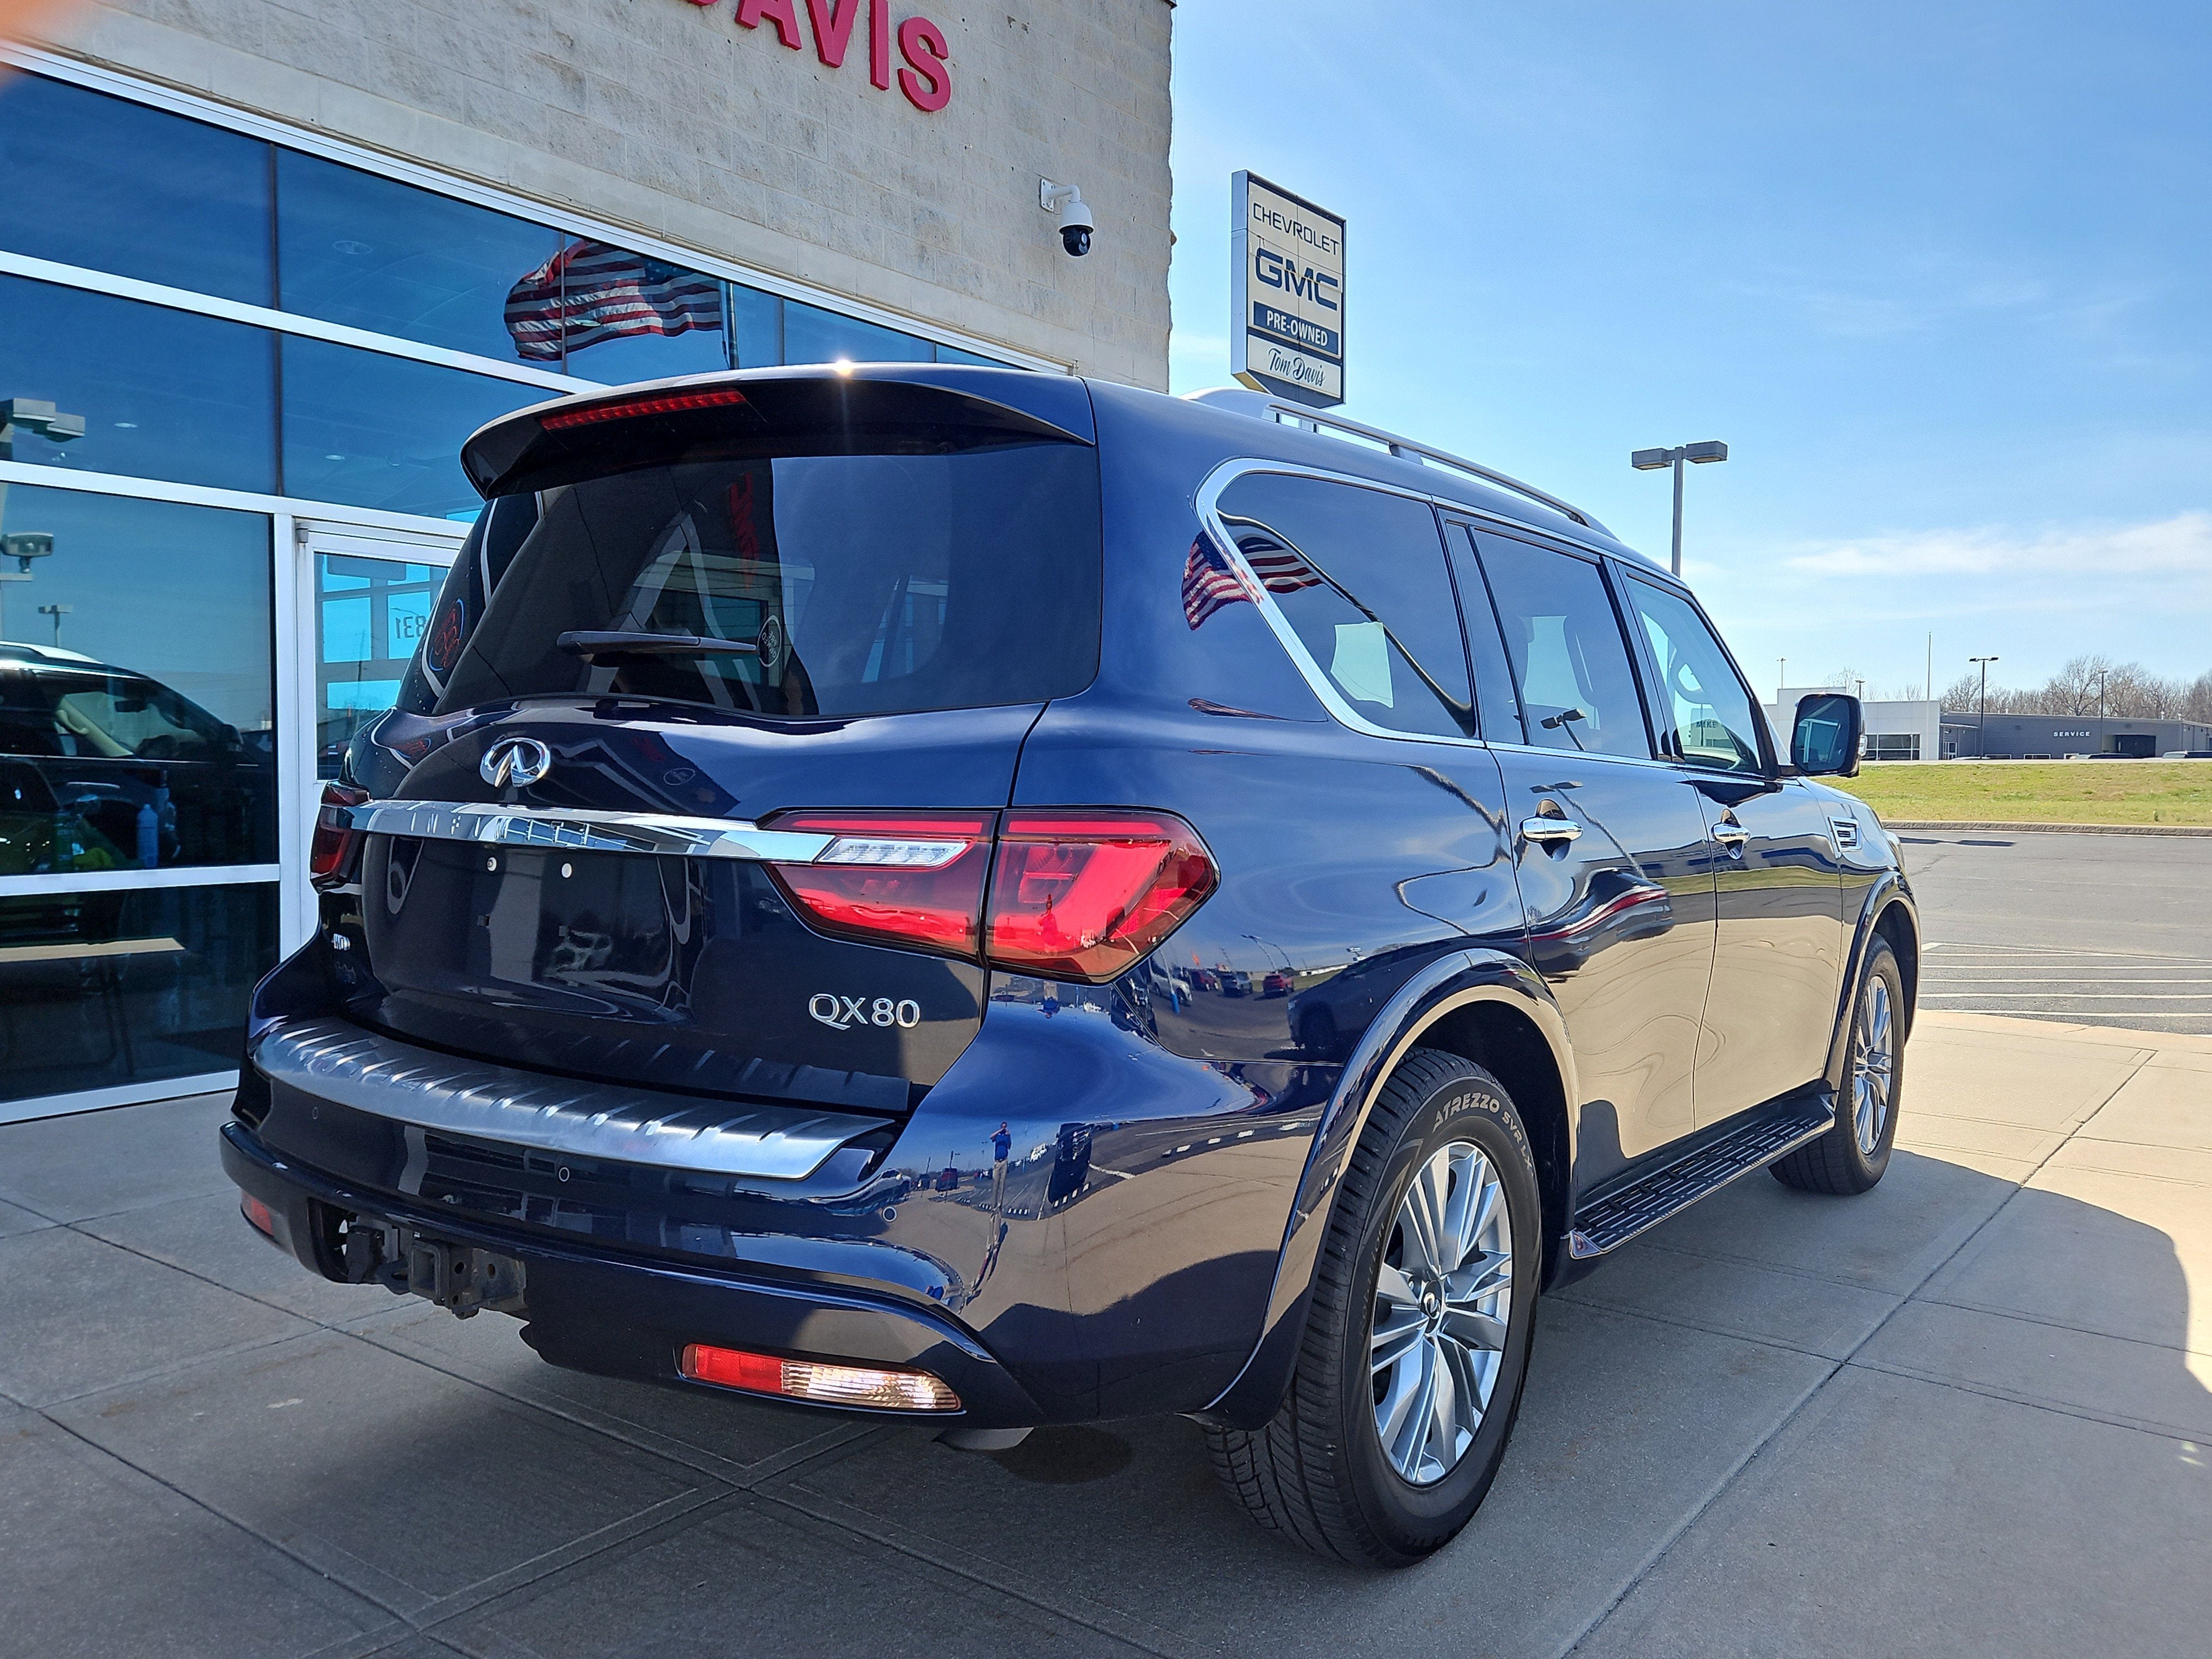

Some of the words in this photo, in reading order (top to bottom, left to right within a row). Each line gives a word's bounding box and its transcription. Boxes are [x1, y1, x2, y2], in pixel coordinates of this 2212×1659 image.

[687, 0, 951, 112] VIS
[1253, 203, 1339, 255] CHEVROLET
[1255, 247, 1339, 312] GMC
[1266, 310, 1328, 347] PRE-OWNED
[1268, 348, 1292, 375] Tom
[1290, 357, 1326, 387] Davis
[808, 993, 921, 1031] QX80
[1432, 1092, 1501, 1134] ATREZZO
[1501, 1111, 1523, 1144] SVR
[1520, 1144, 1533, 1171] LX
